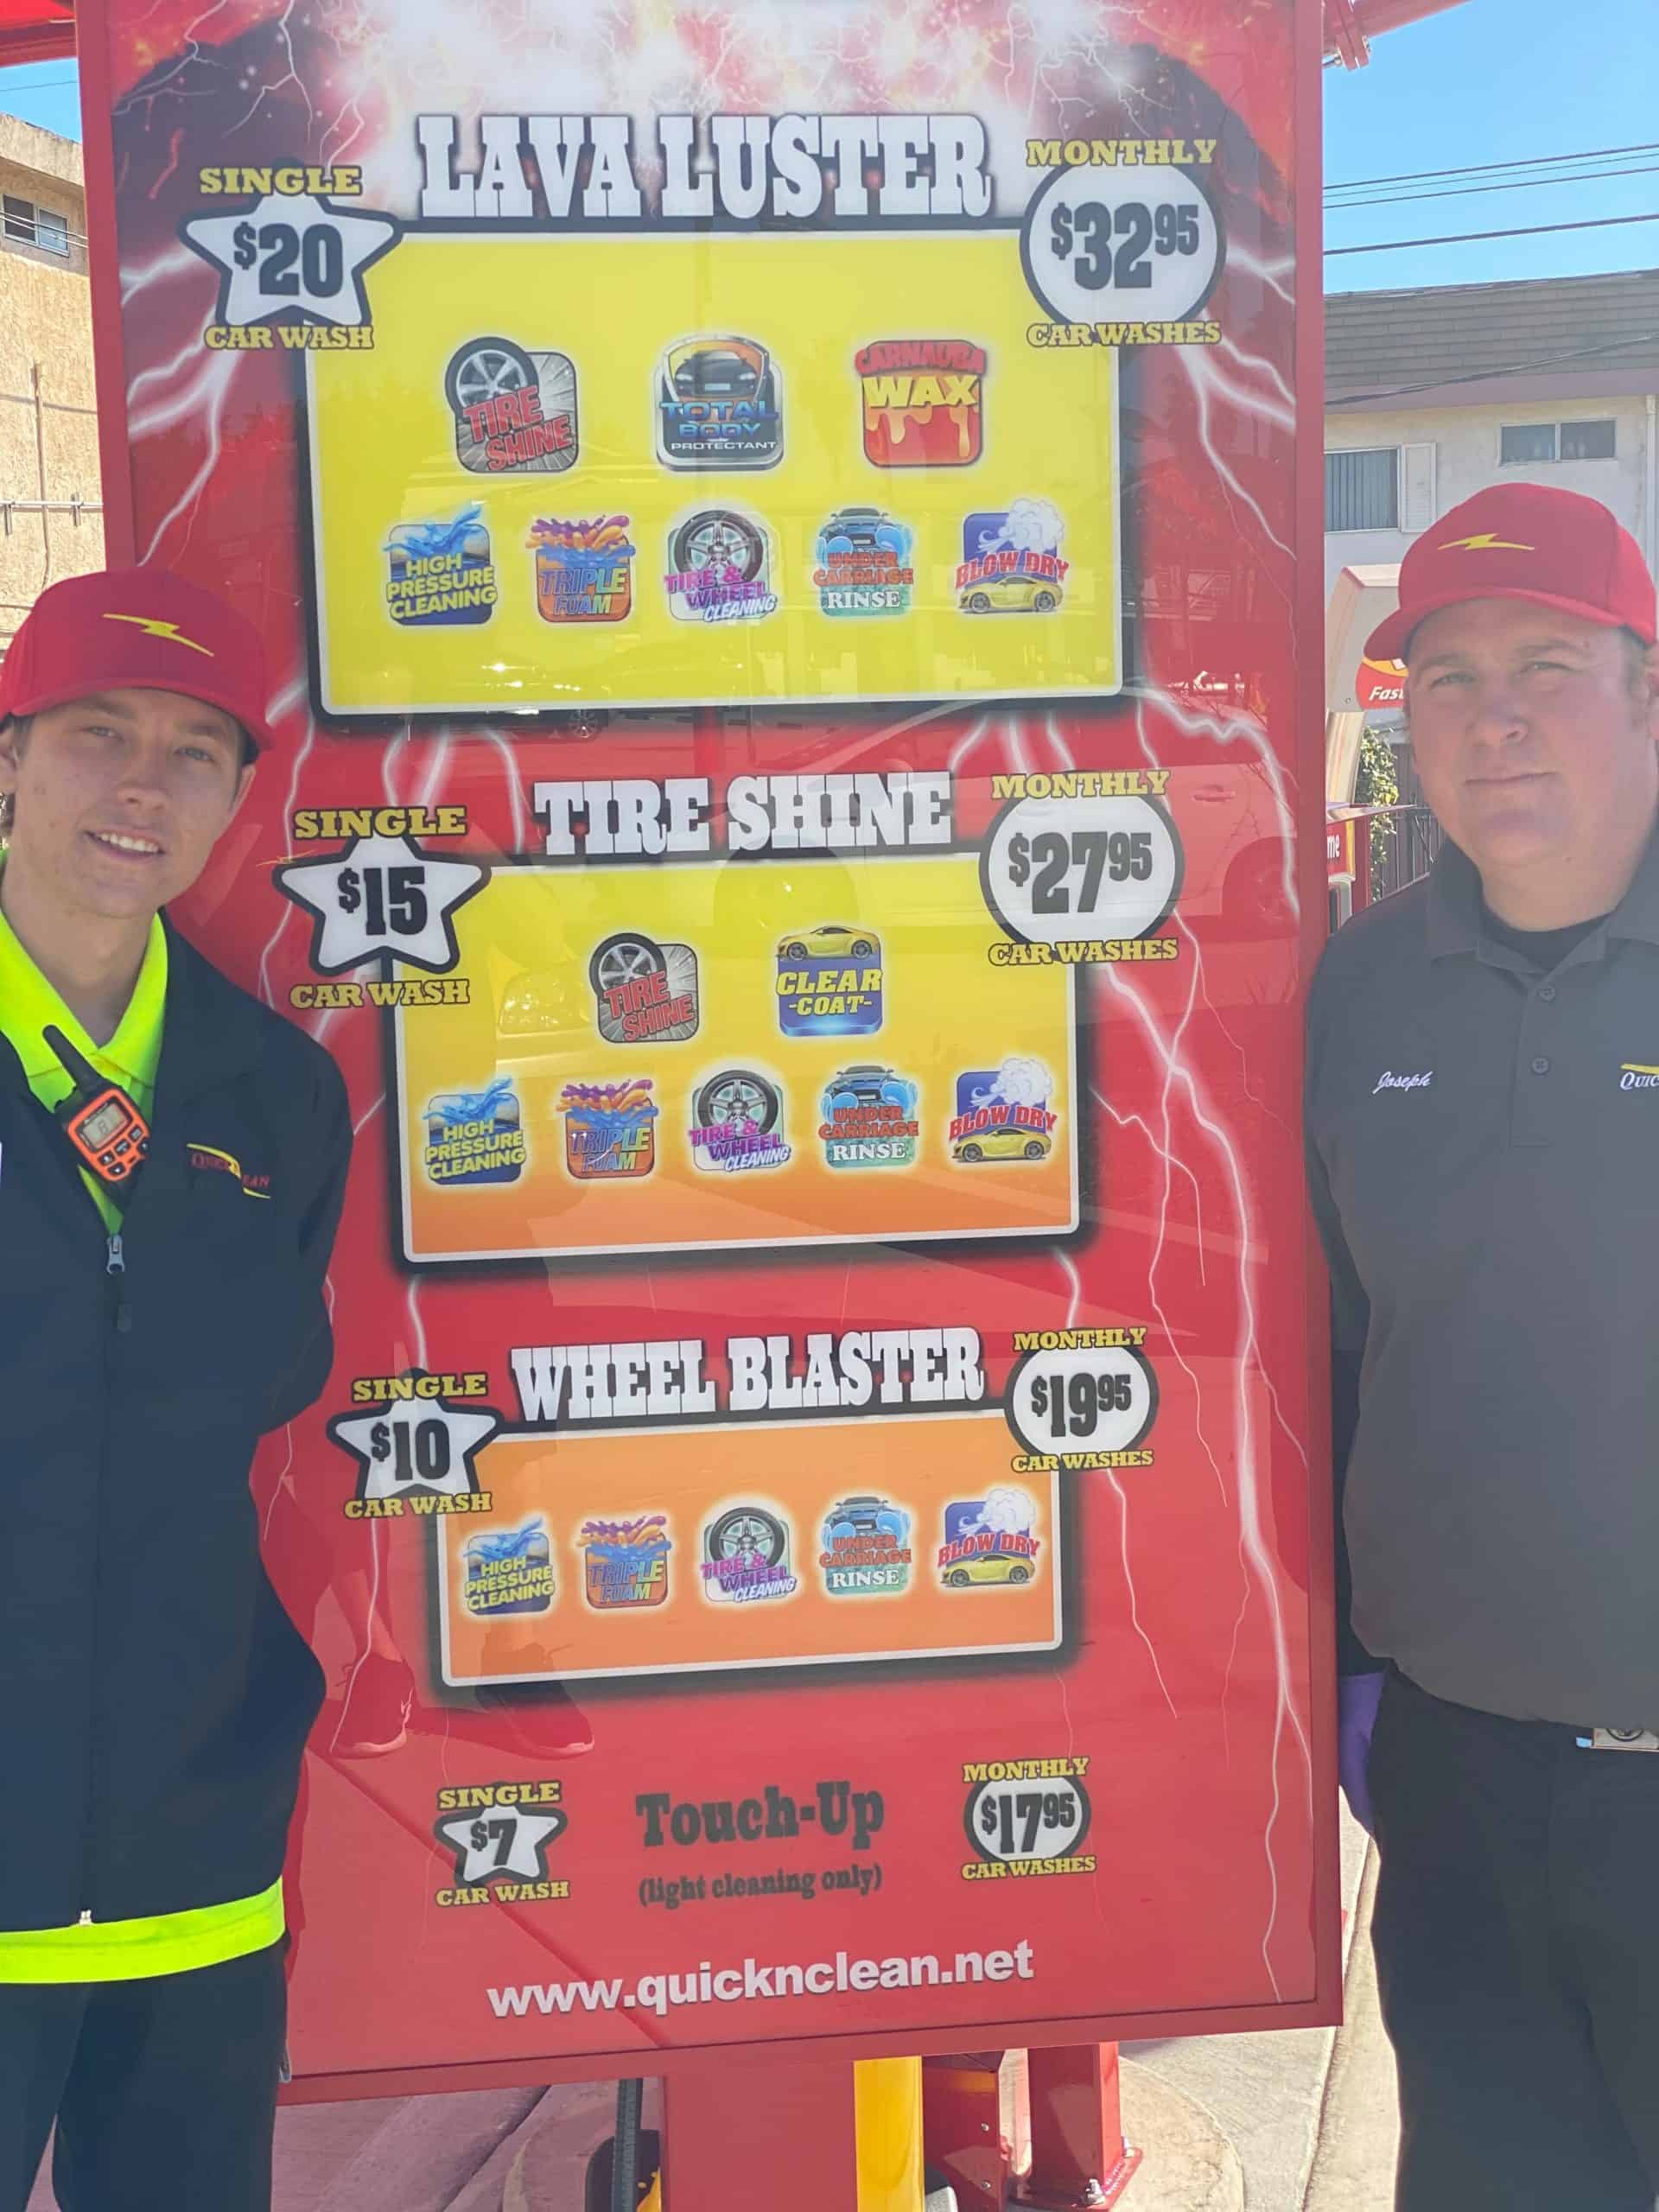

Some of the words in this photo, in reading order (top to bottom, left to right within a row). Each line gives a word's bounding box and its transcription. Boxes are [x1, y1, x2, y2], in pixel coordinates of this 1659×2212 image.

[418, 115, 641, 217] LAVA
[659, 113, 992, 218] LUSTER
[1027, 139, 1217, 167] MONTHLY
[200, 167, 361, 194] SINGLE
[232, 221, 344, 297] $20
[205, 326, 275, 349] CAR
[276, 325, 374, 349] WASH
[1027, 323, 1096, 346] CAR
[1096, 321, 1221, 346] WASHES
[855, 342, 986, 374] CARNAUBA
[862, 374, 978, 407] WAX
[462, 385, 543, 443] TIRE
[659, 400, 778, 422] TOTAL
[486, 416, 574, 471] SHINE
[678, 422, 761, 439] BODY
[671, 441, 777, 450] PROTECTANT
[406, 553, 462, 577] HIGH
[826, 551, 898, 568] UNDER
[956, 551, 1018, 588] BLOW
[1026, 552, 1069, 581] DRY
[387, 566, 495, 600] PRESSURE
[540, 567, 627, 595] TRIPLE
[664, 569, 716, 593] TIRE
[723, 566, 741, 583] &
[391, 585, 498, 619] CLEANING
[553, 594, 612, 614] FOAM
[687, 582, 765, 609] WHEEL
[703, 594, 777, 622] CLEANING
[827, 591, 899, 608] RINSE
[991, 771, 1172, 799] MONTHLY
[294, 807, 467, 838] SINGLE
[534, 779, 710, 855] TIRE
[727, 772, 950, 850] SHINE
[338, 867, 428, 935] $15
[988, 943, 1056, 966] CAR
[1058, 938, 1178, 964] WASHES
[289, 984, 362, 1009] CAR
[365, 979, 470, 1007] WASH
[604, 970, 670, 1020] TIRE
[776, 969, 883, 995] CLEAR
[622, 995, 695, 1041] SHINE
[1372, 1071, 1433, 1095] Joseph
[833, 1106, 903, 1122] UNDER
[950, 1105, 1009, 1140] BLOW
[1016, 1106, 1058, 1131] DRY
[442, 1120, 493, 1142] HIGH
[571, 1127, 651, 1154] TRIPLE
[689, 1124, 734, 1147] TIRE
[742, 1119, 760, 1135] &
[818, 1121, 918, 1140] CARRIAGE
[424, 1129, 524, 1164] PRESSURE
[708, 1134, 780, 1160] WHEEL
[725, 1147, 791, 1172] CLEANING
[832, 1142, 906, 1161] RINSE
[429, 1147, 525, 1179] CLEANING
[1013, 1327, 1147, 1351] MONTHLY
[353, 1373, 487, 1402] SINGLE
[511, 1339, 715, 1421] WHEEL
[728, 1327, 985, 1411] BLASTER
[370, 1419, 449, 1481] $10
[1011, 1455, 1059, 1473] CAR
[1061, 1450, 1154, 1470] WASHES
[345, 1497, 403, 1519] CAR
[412, 1492, 493, 1515] WASH
[832, 1535, 898, 1551] UNDER
[938, 1534, 995, 1567] BLOW
[1000, 1534, 1041, 1556] DRY
[480, 1556, 526, 1577] HIGH
[589, 1560, 664, 1586] TRIPLE
[701, 1556, 745, 1579] TIRE
[752, 1553, 767, 1568] &
[719, 1566, 787, 1592] WHEEL
[832, 1570, 899, 1588] RINSE
[465, 1566, 553, 1598] PRESSURE
[734, 1576, 797, 1603] CLEANING
[467, 1582, 555, 1611] CLEANING
[962, 1757, 1090, 1783] MONTHLY
[438, 1781, 561, 1810] SINGLE
[636, 1781, 884, 1850] Touch-Up
[470, 1818, 518, 1866] $7
[961, 1860, 1007, 1880] CAR
[1009, 1855, 1096, 1877] WASHES
[436, 1886, 490, 1907] CAR
[494, 1880, 570, 1903] WASH
[639, 1872, 706, 1910] (light
[711, 1868, 817, 1899] cleaning
[821, 1863, 883, 1896] only)
[487, 1939, 1034, 2018] www.quicknclean.net
